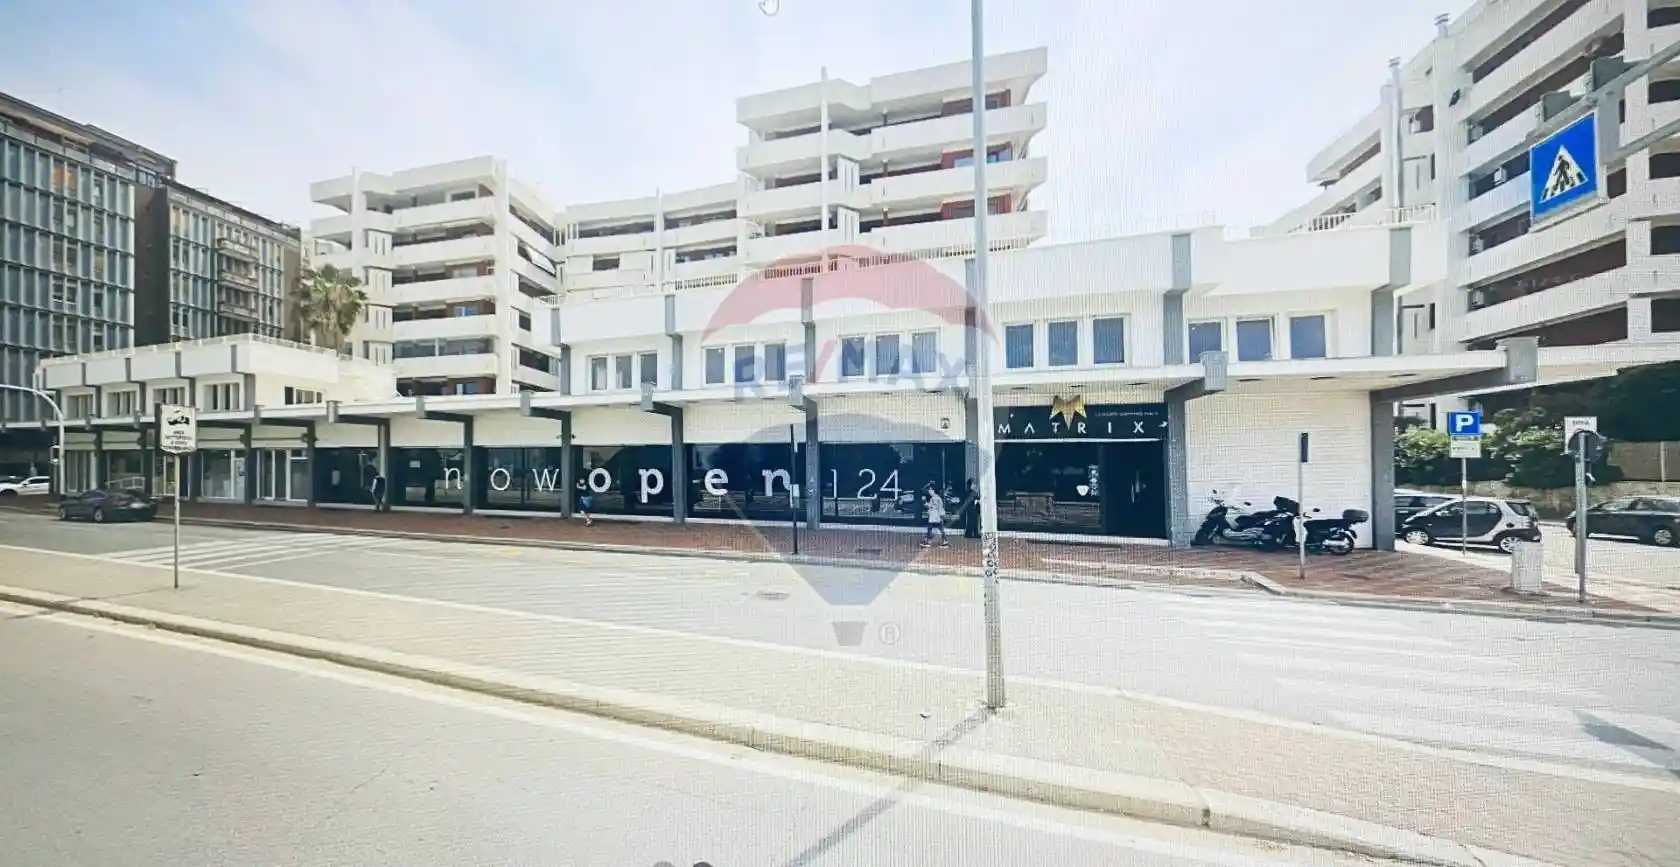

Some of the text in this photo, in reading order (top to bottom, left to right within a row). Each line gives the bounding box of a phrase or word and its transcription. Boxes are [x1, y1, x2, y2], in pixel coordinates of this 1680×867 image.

[997, 421, 1145, 435] MATRIX
[1455, 414, 1474, 432] P
[443, 467, 902, 504] now open 124
